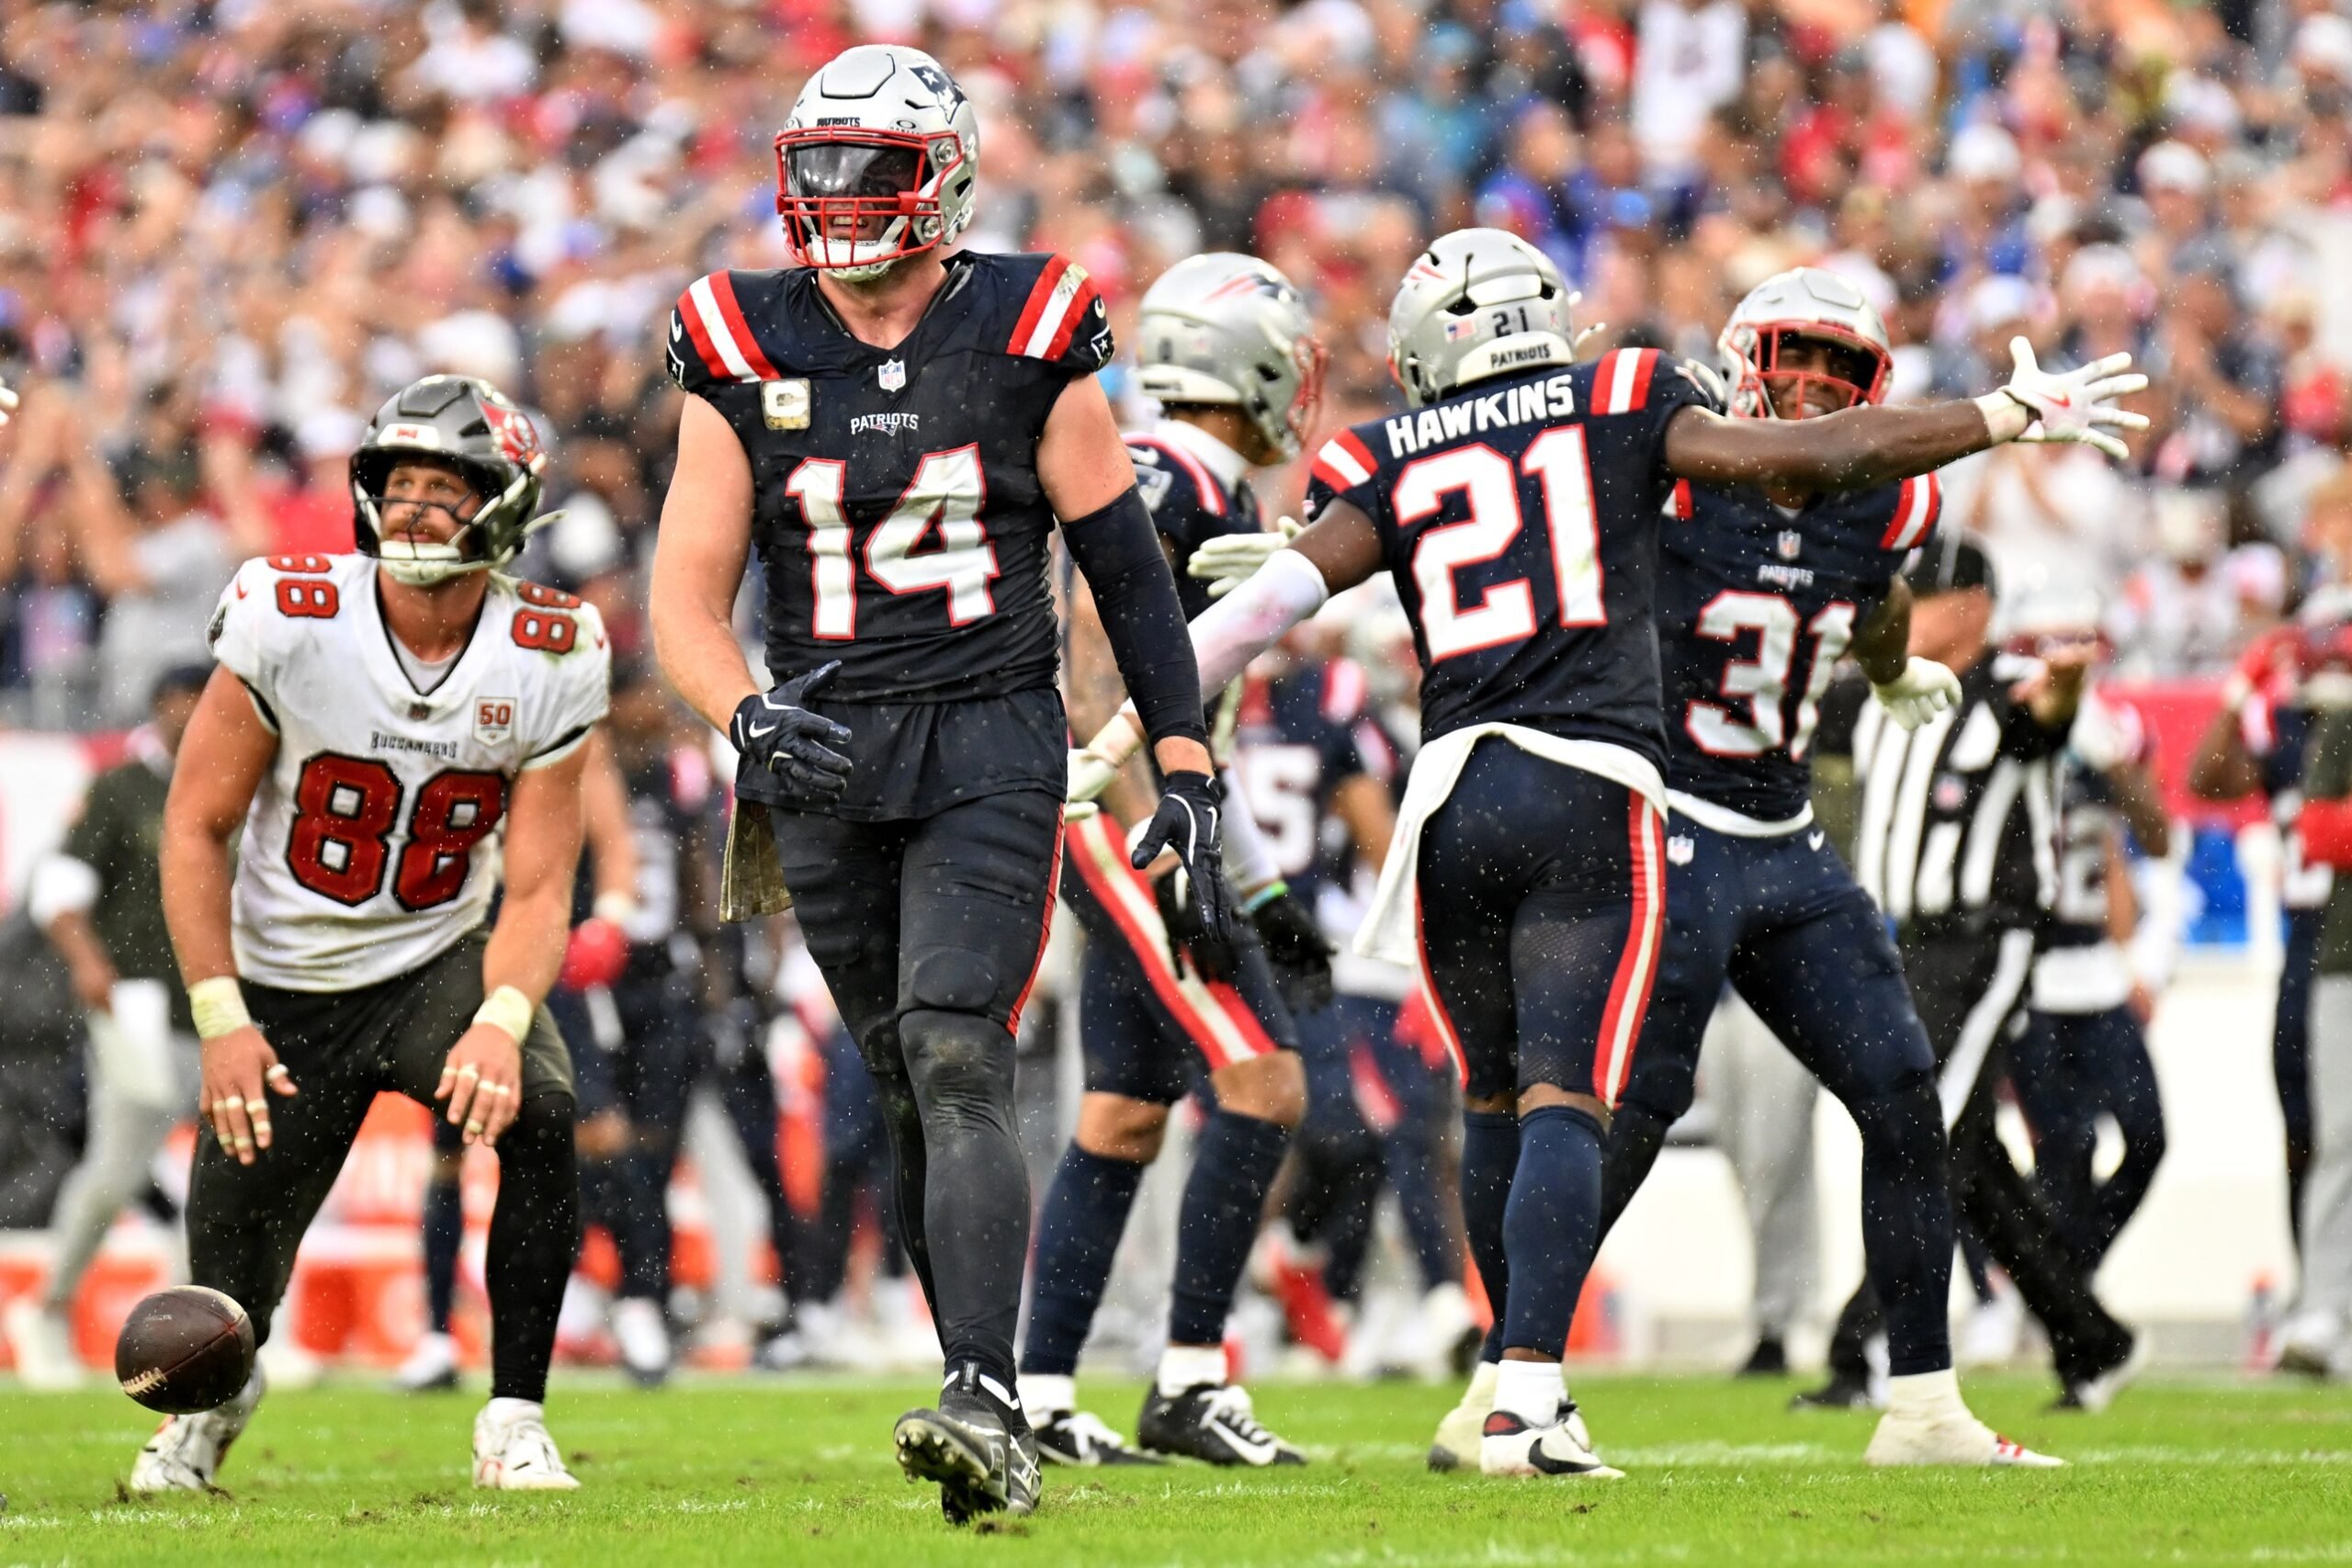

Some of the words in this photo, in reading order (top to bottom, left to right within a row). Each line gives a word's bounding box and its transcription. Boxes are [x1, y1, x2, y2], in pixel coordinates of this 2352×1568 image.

[1491, 306, 1530, 338] 21
[1490, 343, 1552, 368] PATRIOTS
[850, 412, 920, 435] PATRIOTS
[1385, 374, 1575, 459] HAWKINS
[785, 441, 1001, 640] 14
[1391, 423, 1608, 665] 21
[1684, 588, 1858, 763] 31
[479, 703, 512, 726] 50
[370, 731, 458, 759] BUCCANEERS
[284, 750, 507, 913] 88
